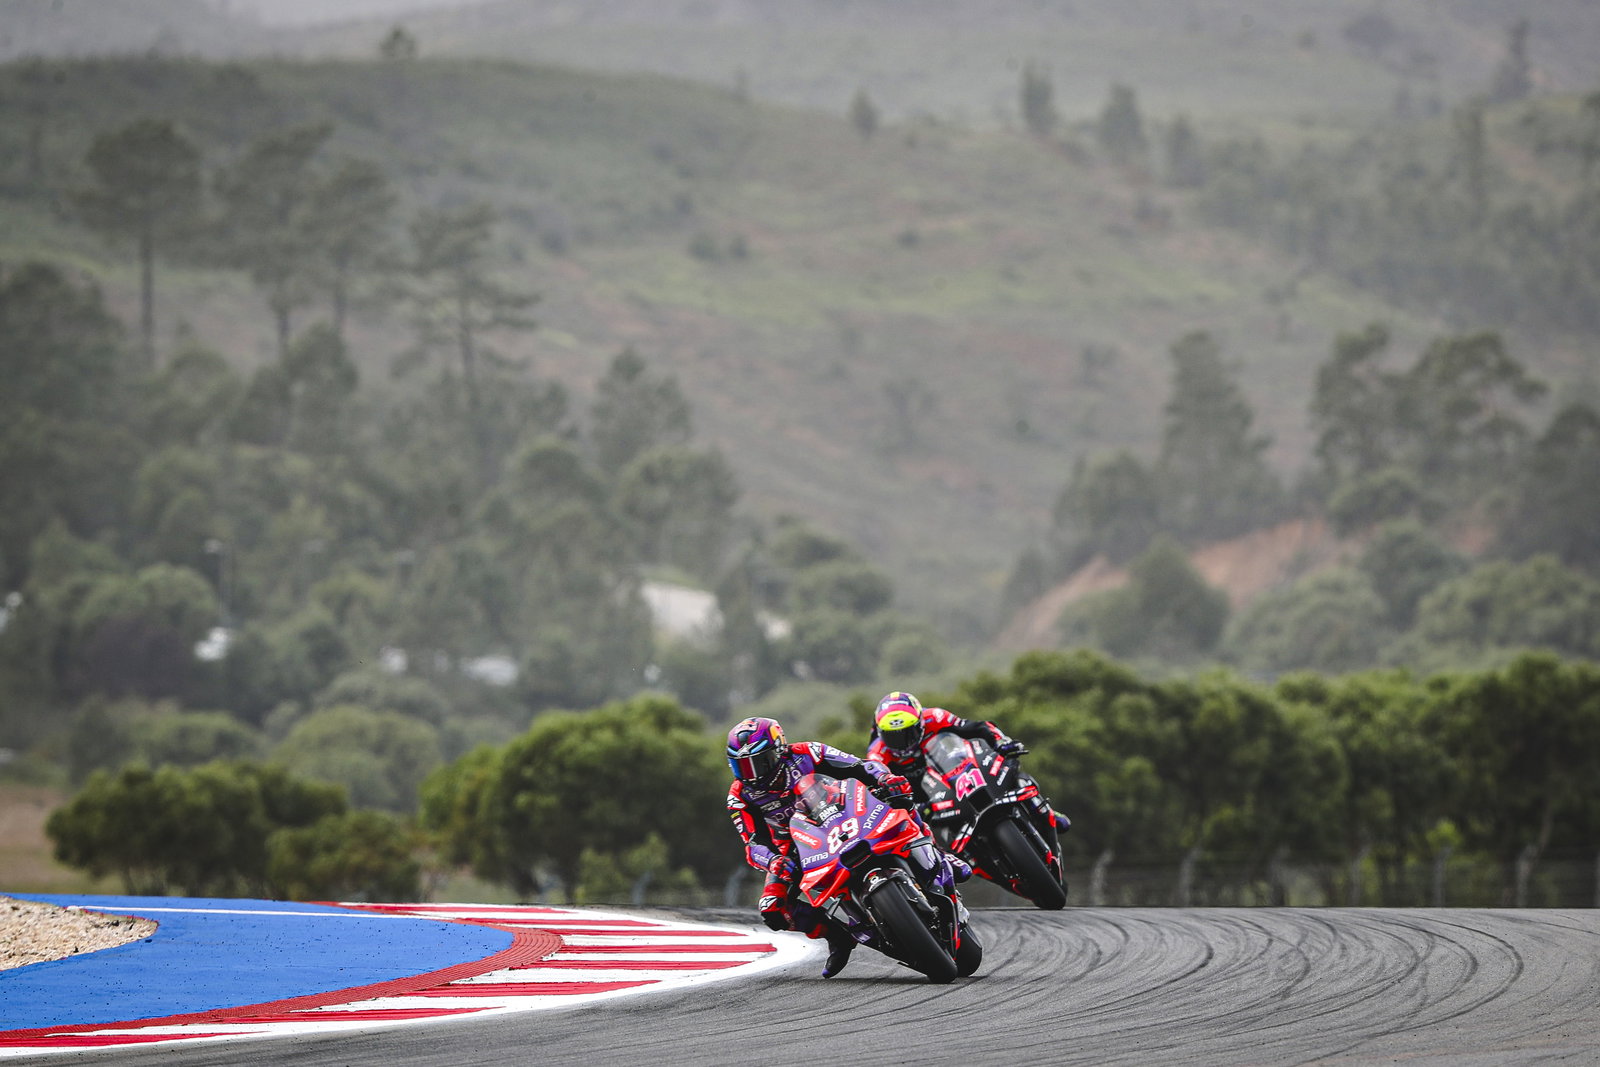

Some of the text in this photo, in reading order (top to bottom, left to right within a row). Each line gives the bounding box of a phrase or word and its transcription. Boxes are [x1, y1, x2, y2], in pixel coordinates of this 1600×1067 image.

[955, 768, 987, 801] 41
[863, 804, 885, 830] prima
[826, 816, 860, 855] 89
[801, 851, 829, 868] prima
